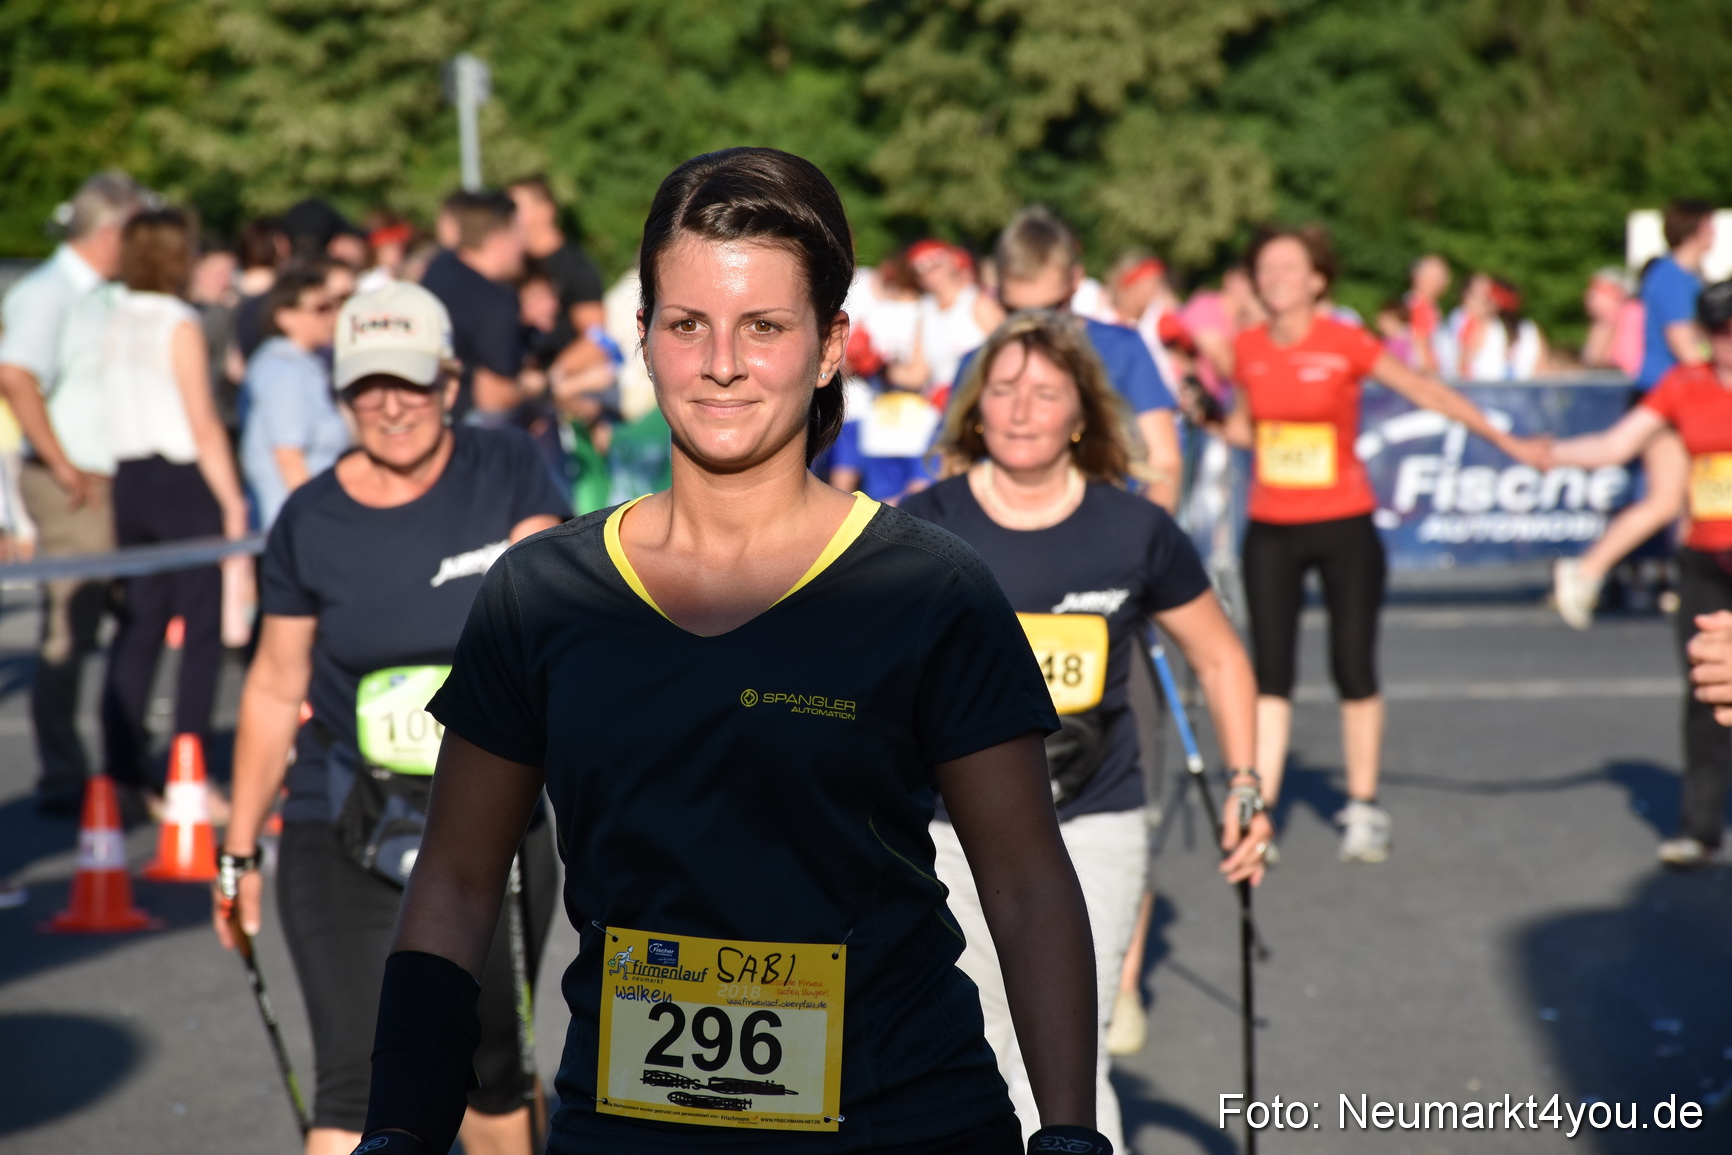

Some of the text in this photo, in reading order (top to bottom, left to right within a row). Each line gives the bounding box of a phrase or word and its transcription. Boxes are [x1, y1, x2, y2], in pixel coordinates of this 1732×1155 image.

[763, 693, 856, 713] SPANGLER
[791, 706, 855, 720] AUTOMATION
[632, 960, 709, 983] firmenlauf
[717, 946, 796, 987] SABI
[632, 976, 664, 985] neumarkt
[615, 984, 673, 1004] walken
[717, 983, 762, 1000] 2018
[644, 1002, 782, 1075] 296
